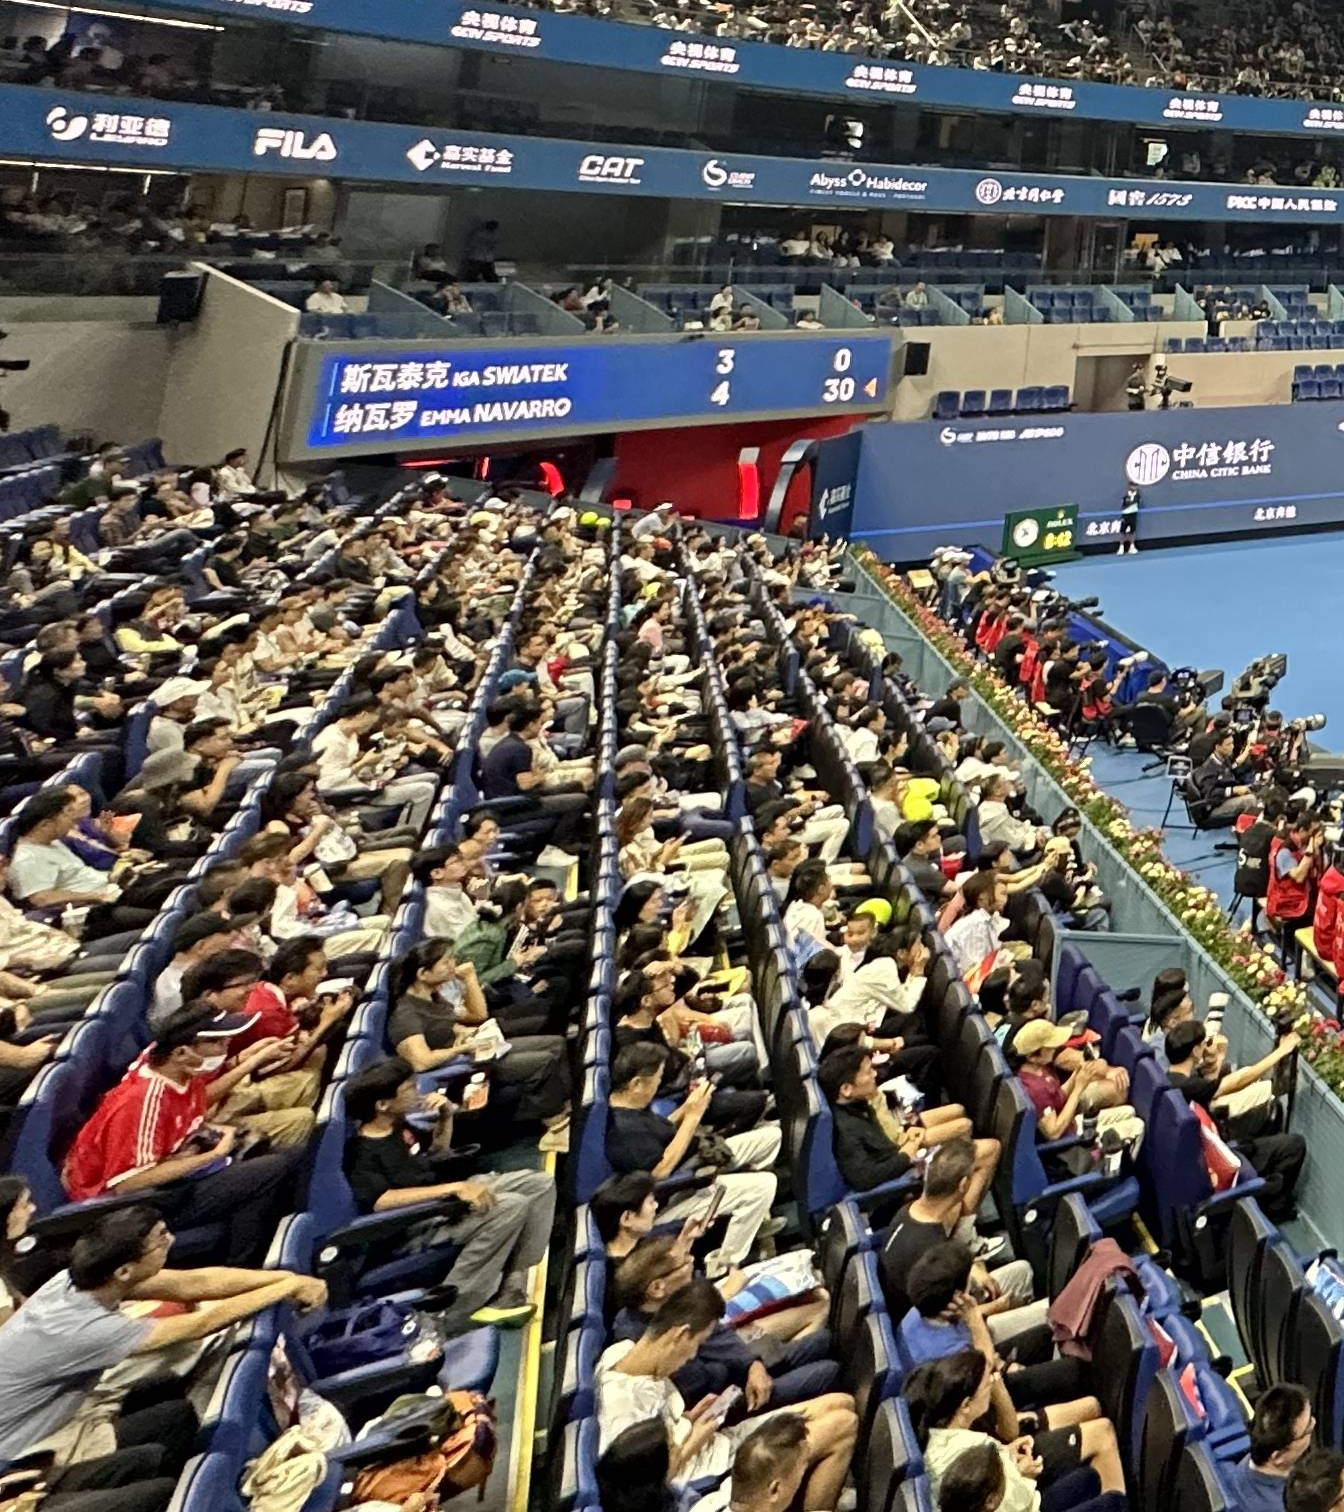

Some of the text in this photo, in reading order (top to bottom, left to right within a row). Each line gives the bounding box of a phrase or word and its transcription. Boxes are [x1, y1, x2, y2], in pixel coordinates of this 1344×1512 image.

[462, 11, 537, 35] 央视体育
[255, 129, 336, 160] FILA
[579, 155, 644, 178] CAT
[810, 173, 927, 193] Abyss Habidecor
[717, 350, 734, 374] 3
[834, 349, 851, 371] 0
[342, 360, 568, 393] 斯瓦泰克 IGA SWIATEK
[711, 381, 729, 405] 4
[823, 378, 854, 402] 30
[335, 398, 571, 434] 纳瓦罗 EMMA NAVARRO
[1172, 438, 1275, 468] 中信银行
[1172, 464, 1272, 480] CHINA CITIC BANK
